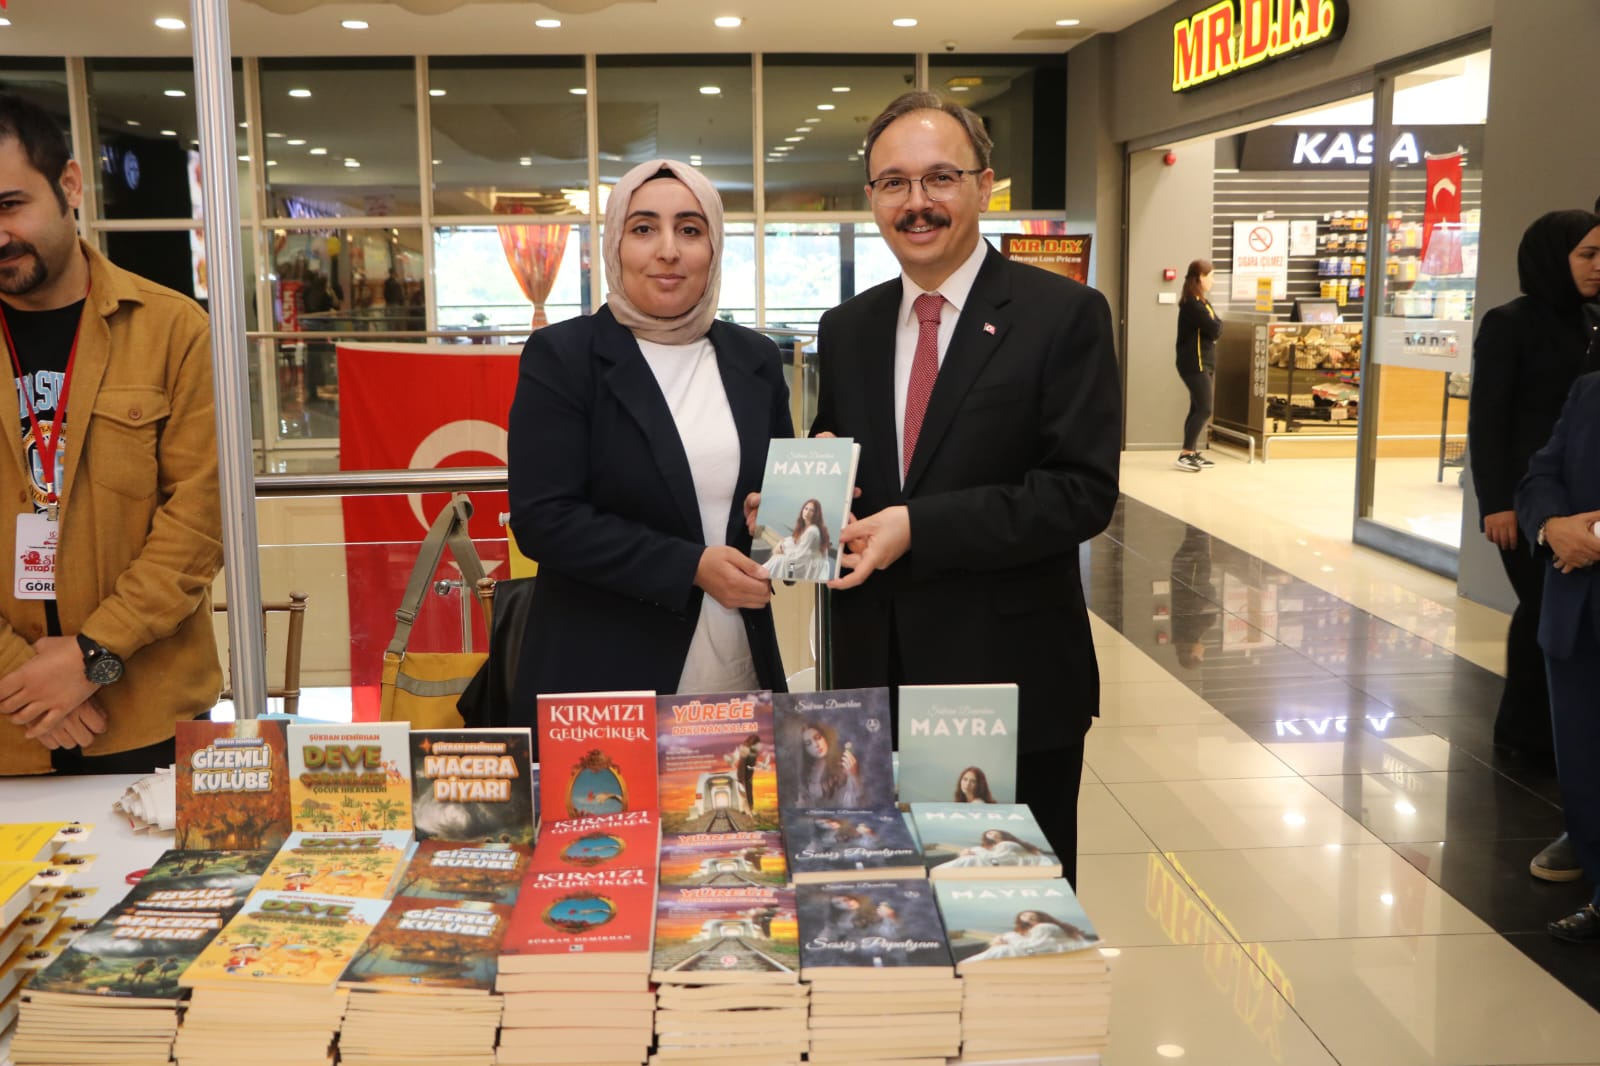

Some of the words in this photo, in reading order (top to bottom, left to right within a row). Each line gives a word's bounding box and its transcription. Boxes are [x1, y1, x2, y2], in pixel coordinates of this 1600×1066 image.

[773, 461, 841, 475] MAYRA
[550, 704, 644, 726] KIRMIZI
[672, 698, 755, 723] YÜREĞE
[910, 718, 1007, 736] MAYRA
[193, 746, 269, 769] GİZEMLİ
[303, 745, 382, 769] DEVE
[426, 757, 516, 777] MACERA
[194, 769, 269, 791] KULÜBE
[436, 777, 509, 800] DİYARI
[555, 811, 648, 828] KIRMIZI
[925, 812, 1025, 820] MAYRA
[300, 837, 382, 847] DEVE
[537, 869, 645, 882] KIRMIZI
[951, 889, 1063, 899] MAYRA
[260, 900, 355, 916] DEVE
[805, 937, 857, 951] Sessiz
